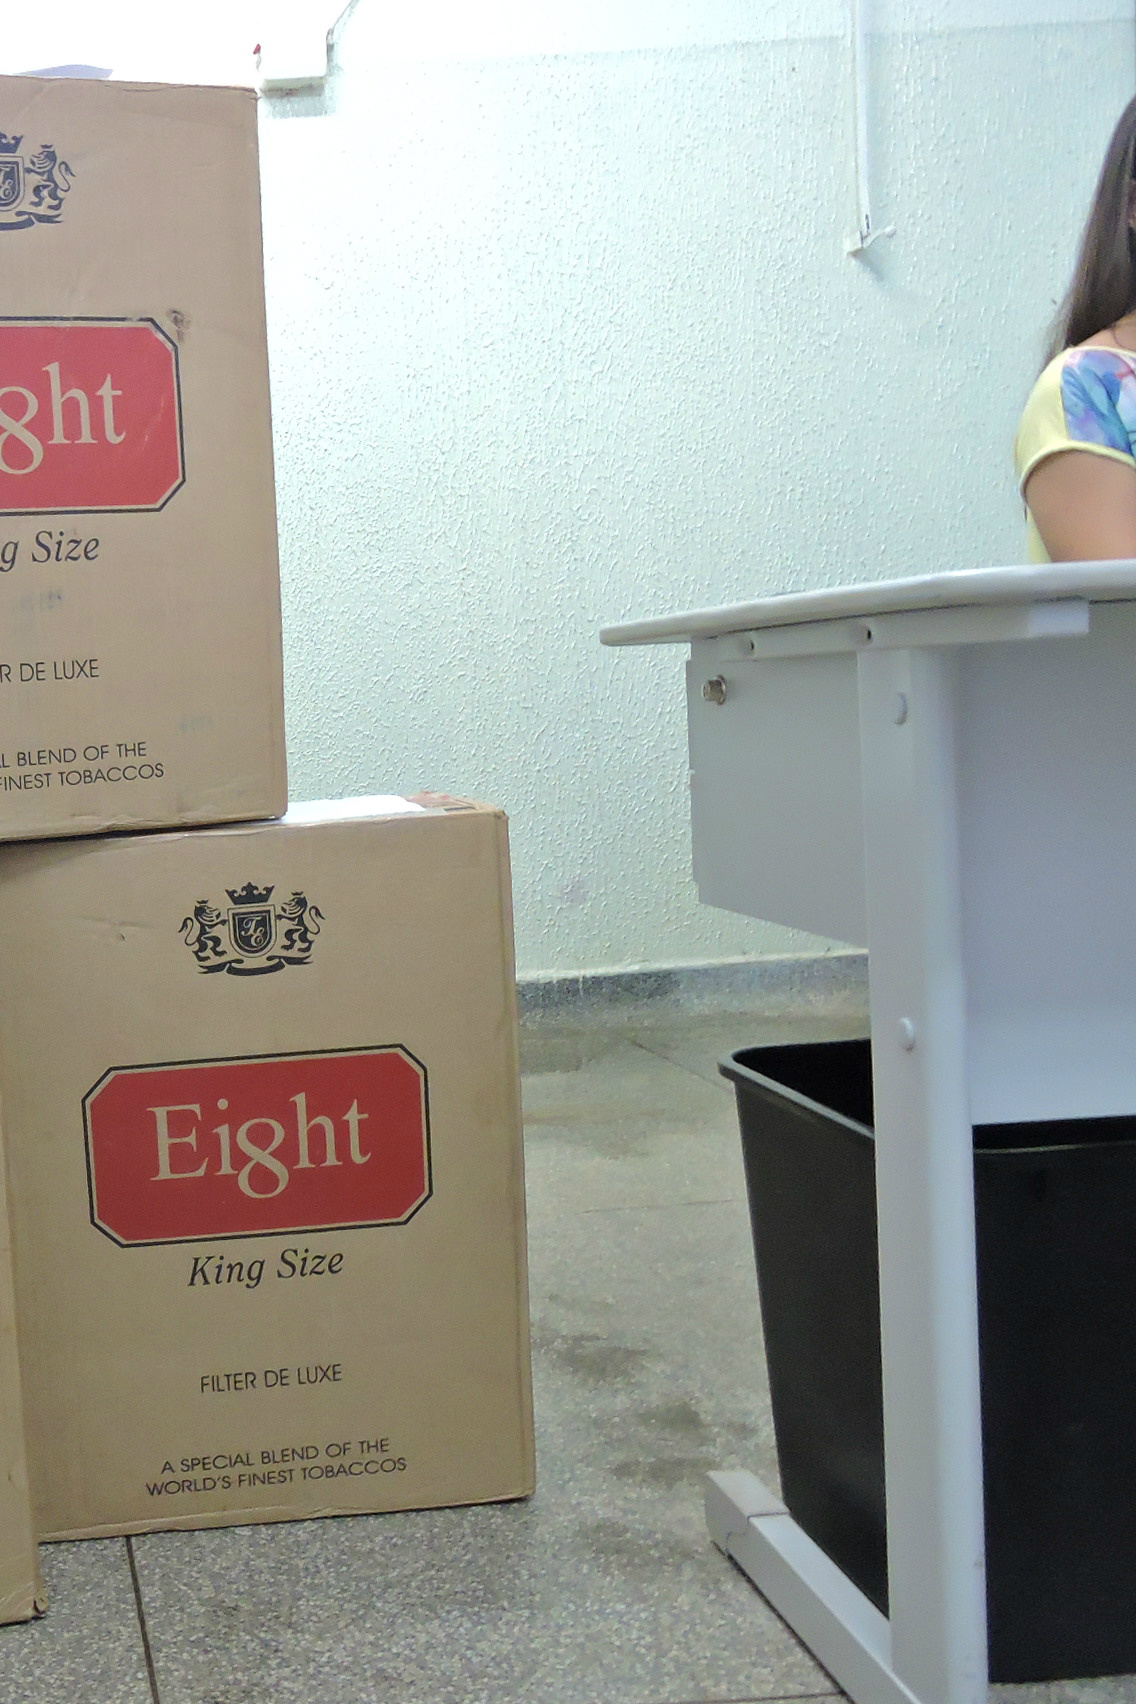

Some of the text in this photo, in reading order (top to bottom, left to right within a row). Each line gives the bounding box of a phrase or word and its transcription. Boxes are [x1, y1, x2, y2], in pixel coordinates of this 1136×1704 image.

[31, 530, 100, 564] Size
[19, 661, 47, 683] DE
[53, 657, 100, 681] LUXE
[16, 747, 77, 767] BLEND
[82, 744, 110, 762] OF
[115, 740, 147, 759] THE
[57, 762, 165, 787] TOBACCOS
[186, 1247, 344, 1290] King Size
[200, 1363, 343, 1394] FILTER DE LUXE
[160, 1436, 390, 1475] A SPECIAL BLEND OF THE
[145, 1456, 408, 1497] WORLD'S FINEST TOBACCOS
